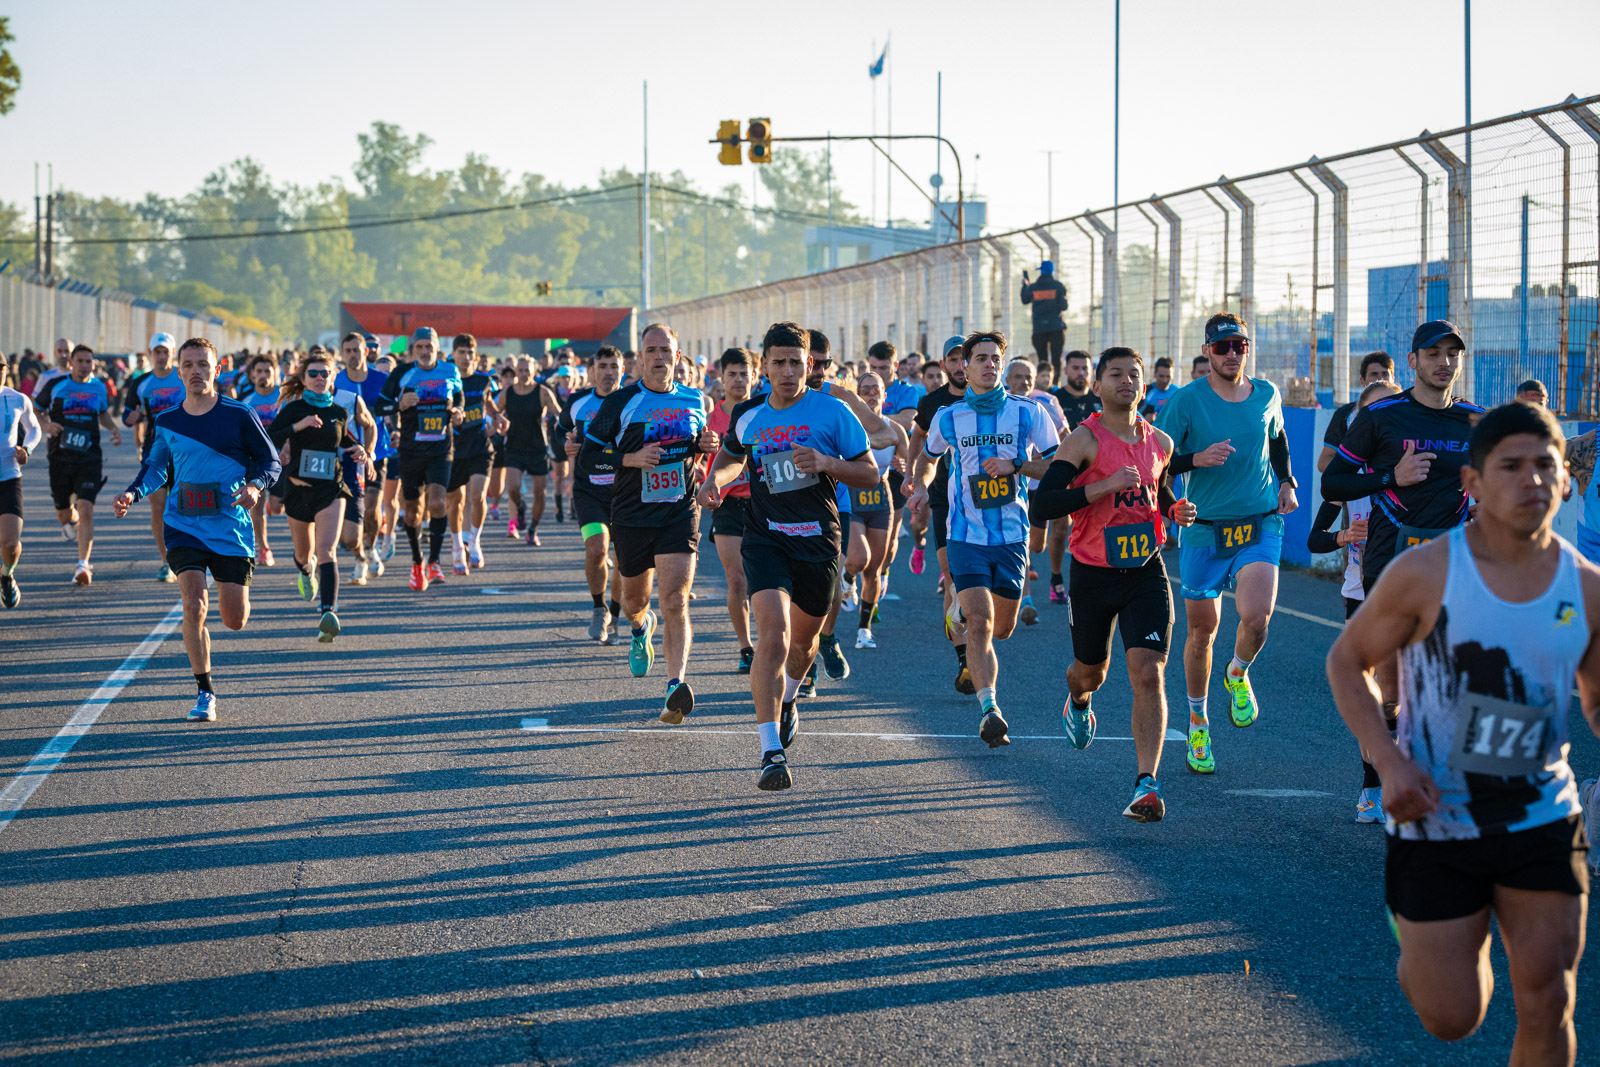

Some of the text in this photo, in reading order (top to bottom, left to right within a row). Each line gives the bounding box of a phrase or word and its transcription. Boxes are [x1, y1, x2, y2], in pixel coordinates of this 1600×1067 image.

[423, 417, 442, 430] 797
[66, 432, 86, 447] 140
[961, 433, 1013, 447] GUEPARD
[310, 457, 325, 473] 21
[650, 469, 679, 490] 359
[978, 477, 1009, 499] 705
[186, 490, 215, 508] 312
[859, 490, 880, 505] 616
[1223, 524, 1252, 547] 747
[1117, 533, 1150, 559] 712
[1473, 713, 1546, 758] 174
